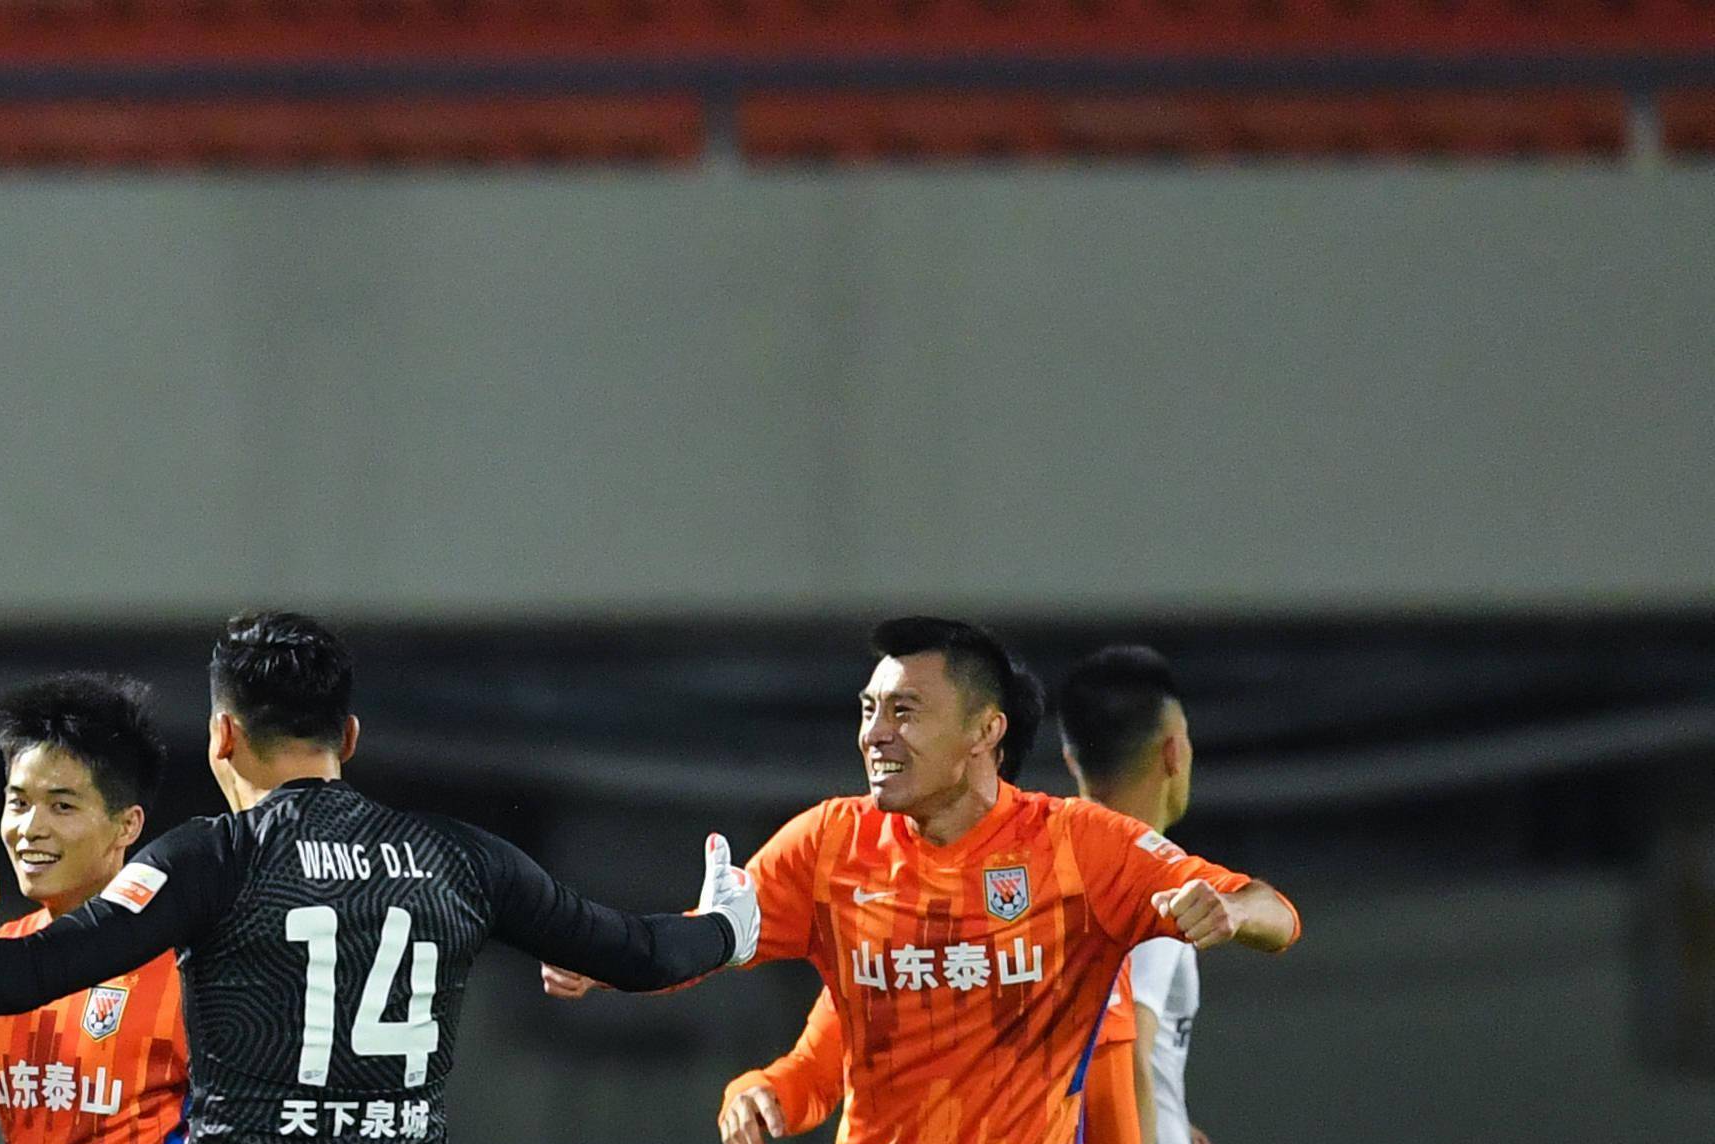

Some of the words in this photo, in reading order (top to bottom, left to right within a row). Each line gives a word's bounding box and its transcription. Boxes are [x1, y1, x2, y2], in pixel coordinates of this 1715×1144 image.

[295, 839, 371, 881] WANG
[380, 841, 434, 880] D.L.
[851, 935, 1045, 993] 山东泰山
[285, 905, 440, 1089] 14
[278, 1099, 431, 1140] 天下泉城
